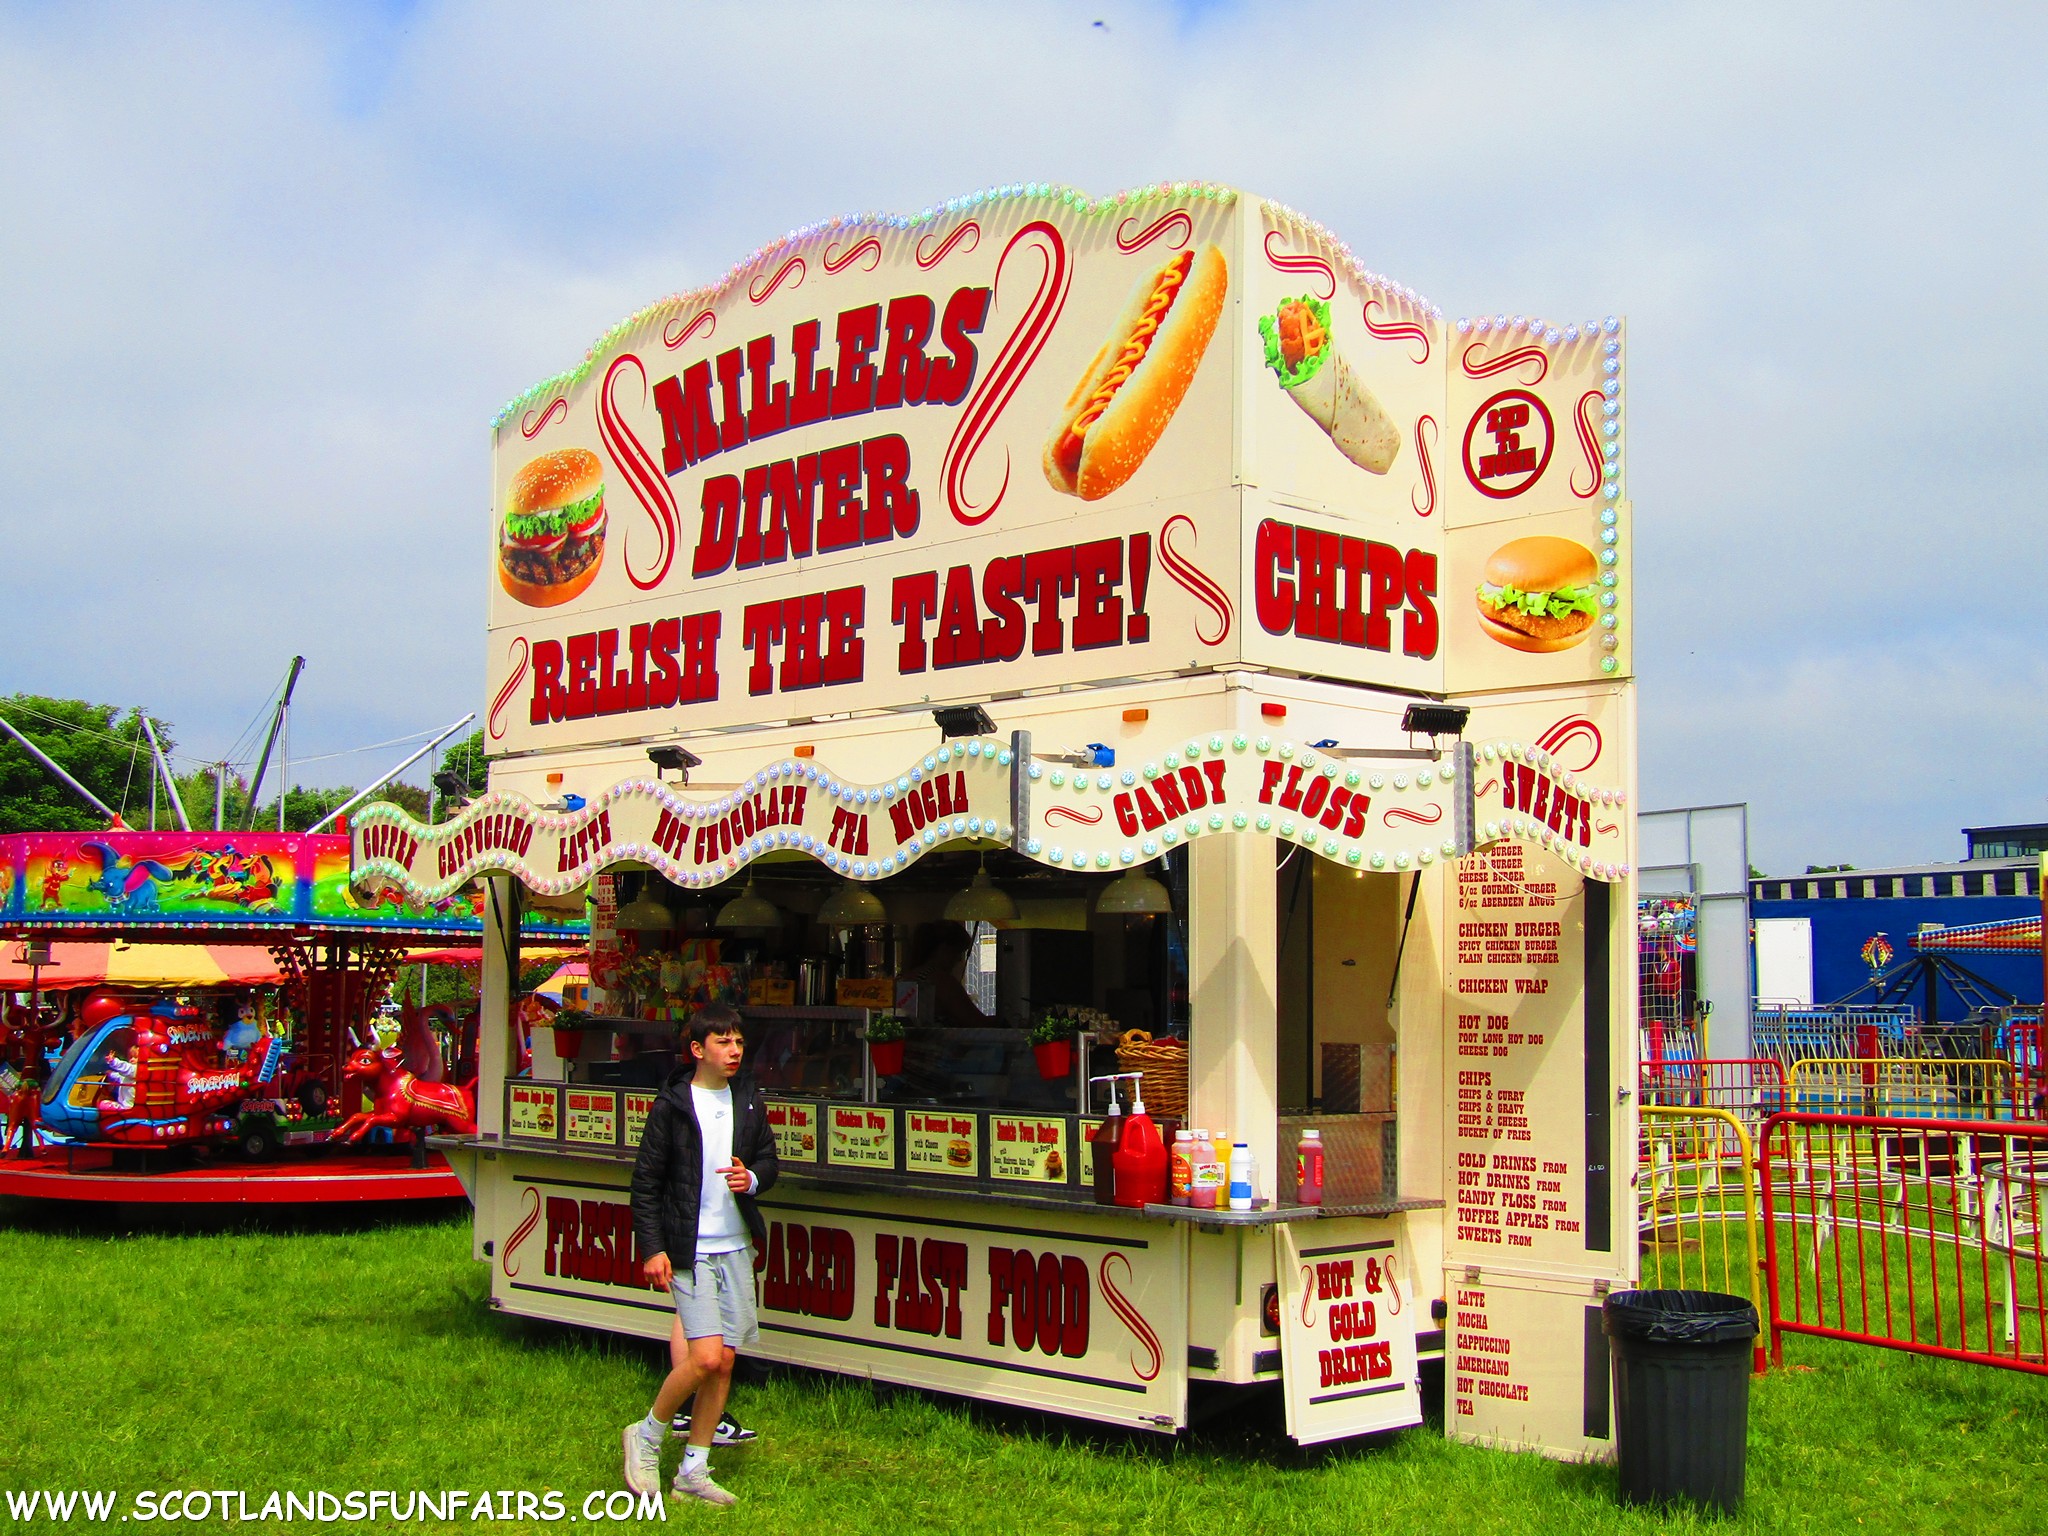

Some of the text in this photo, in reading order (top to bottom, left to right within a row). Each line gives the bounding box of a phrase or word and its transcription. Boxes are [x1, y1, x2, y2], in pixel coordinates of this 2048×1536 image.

[653, 286, 992, 477] MILLERS
[1479, 447, 1536, 479] NONE
[691, 433, 921, 579] DINER
[1255, 517, 1438, 660] CHIPS
[527, 532, 1151, 725] RELISH THE TASTE!
[1114, 760, 1370, 839] CANDY FLOSS
[1503, 760, 1592, 848] SWEETS
[363, 771, 969, 880] COFFEE CAPPUCCINO LATTE HOT CHOCOLATE TEA MOCHA
[1491, 846, 1523, 856] BURGER
[1459, 860, 1475, 872] 1/2
[1491, 859, 1523, 870] BURGER
[1459, 871, 1525, 883] CHEESE BURGER
[1459, 883, 1557, 898] 8/oz GOURMET BURGER
[1459, 896, 1556, 910] 6/oz ABERDEEN ANGUS
[1459, 922, 1561, 937] CHICKEN BURGER
[1459, 940, 1557, 951] SPICY CHICKEN BURGER
[1459, 953, 1559, 963] PLAIN CHICKEN BURGER
[1459, 979, 1548, 994] CHICKEN WRAP
[1458, 1015, 1509, 1030] HOT DOG
[1458, 1033, 1543, 1045] FOOT LONG HOT DOG
[1459, 1045, 1508, 1056] CHEESE DOG
[187, 1072, 240, 1094] SPIDERMAN
[1459, 1071, 1491, 1086] CHIPS
[1459, 1089, 1524, 1101] CHIPS & CURRY
[241, 1100, 275, 1112] SAFARI
[1459, 1101, 1524, 1114] CHIPS & GRAVY
[835, 1109, 887, 1134] Chicken Wrap
[1458, 1114, 1527, 1127] CHIPS & CHEESE
[1458, 1127, 1531, 1140] BUCKET OF FRIES
[1458, 1152, 1567, 1174] COLD DRINKS FROM
[1458, 1171, 1560, 1192] HOT DRINKS FROM
[1458, 1189, 1566, 1212] CANDY FLOSS FROM
[1458, 1207, 1579, 1232] TOFFEE APPLES FROM
[1458, 1226, 1531, 1246] SWEETS FROM
[1316, 1257, 1382, 1300] HOT &
[875, 1234, 968, 1340] FAST
[988, 1247, 1090, 1360] FOOD
[1458, 1290, 1484, 1307] LATTE
[1329, 1301, 1377, 1342] COLD
[1458, 1312, 1487, 1329] MOCHA
[1457, 1334, 1510, 1354] CAPPUCCINO
[1319, 1341, 1392, 1388] DRINKS
[1457, 1356, 1508, 1378] AMERICANO
[1457, 1377, 1528, 1401] HOT CHOCOLATE
[1457, 1399, 1473, 1415] TEA
